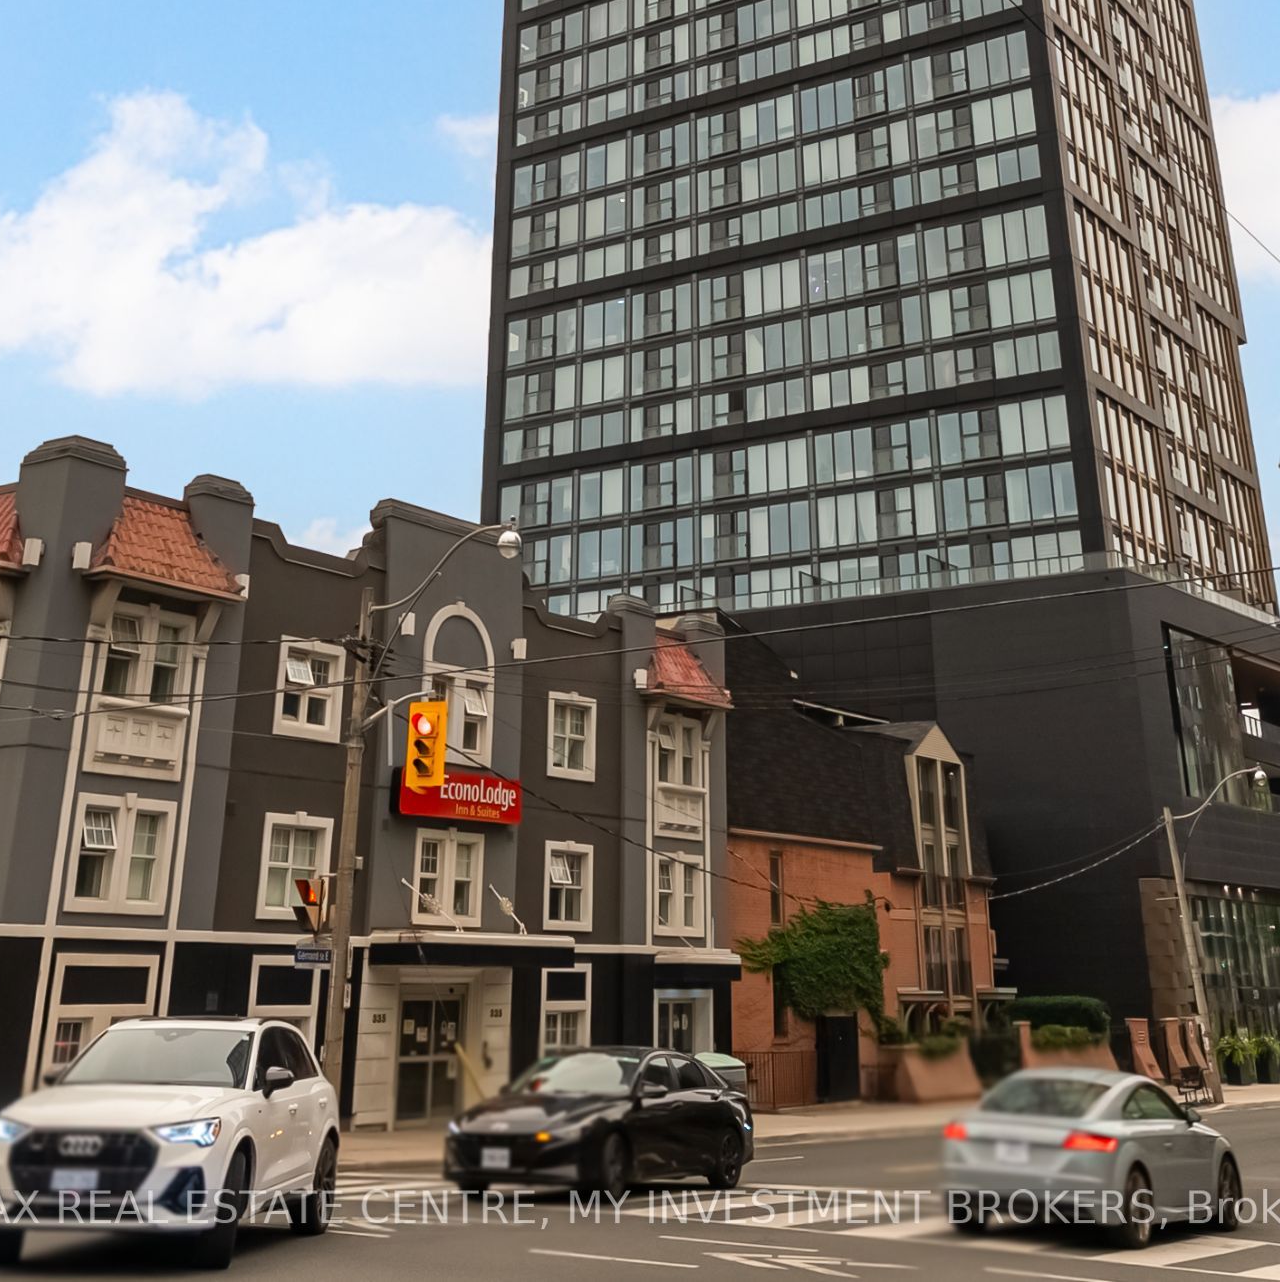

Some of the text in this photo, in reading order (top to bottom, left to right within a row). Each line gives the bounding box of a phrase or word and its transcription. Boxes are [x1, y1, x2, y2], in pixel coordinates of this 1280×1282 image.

[440, 774, 516, 811] EconoLodge
[456, 804, 469, 815] Inn
[477, 806, 500, 818] Suites
